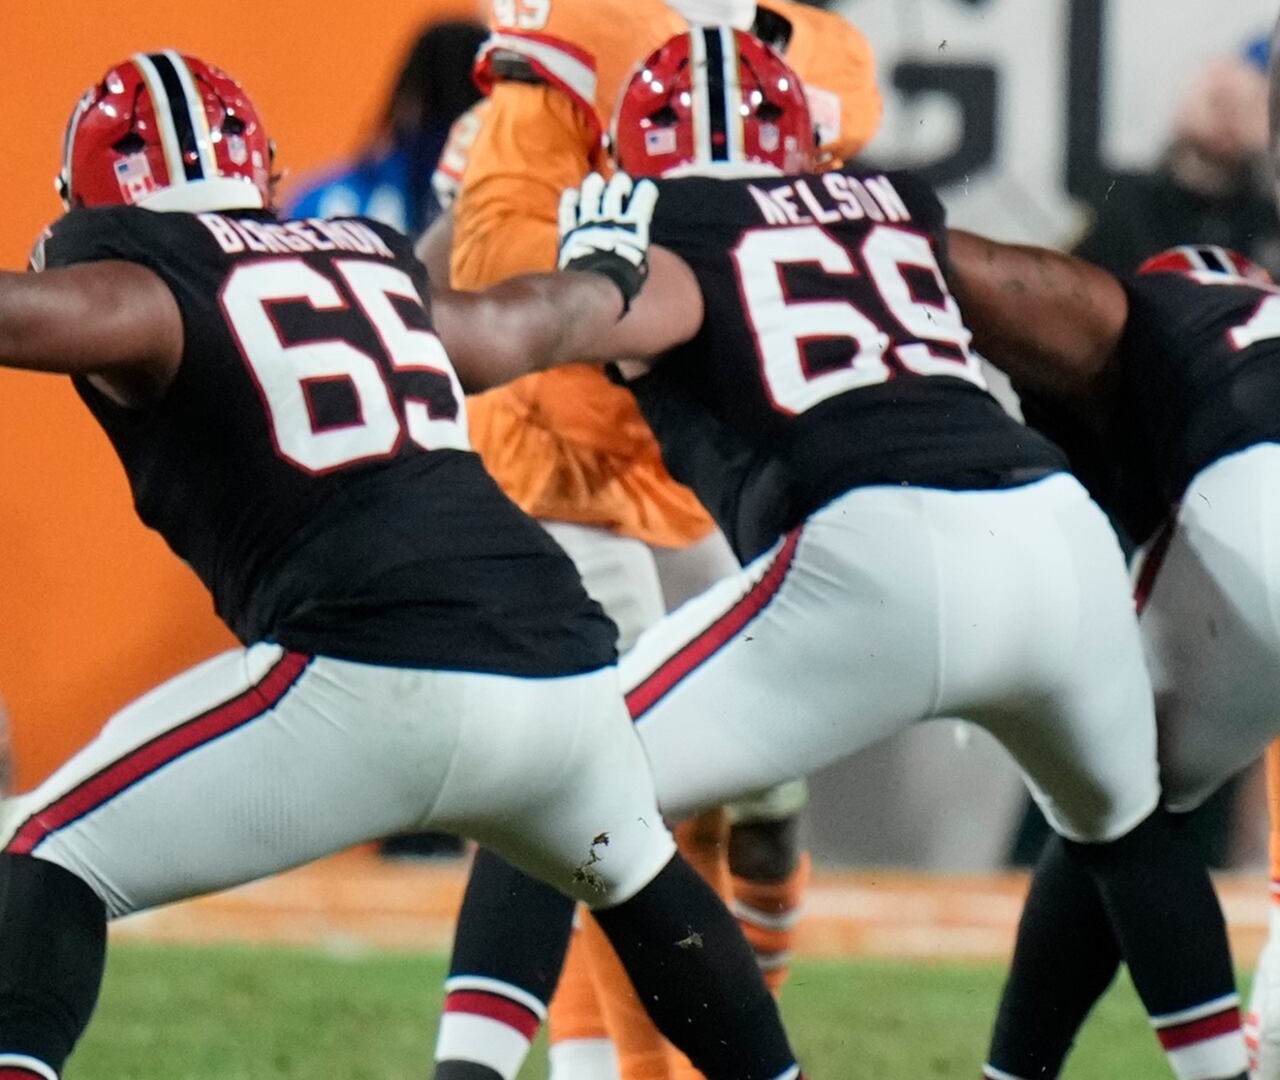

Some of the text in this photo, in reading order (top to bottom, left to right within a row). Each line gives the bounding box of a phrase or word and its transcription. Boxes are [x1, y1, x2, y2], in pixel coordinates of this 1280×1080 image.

[747, 172, 912, 224] NELSON
[219, 256, 470, 476] 65
[731, 222, 988, 416] 69
